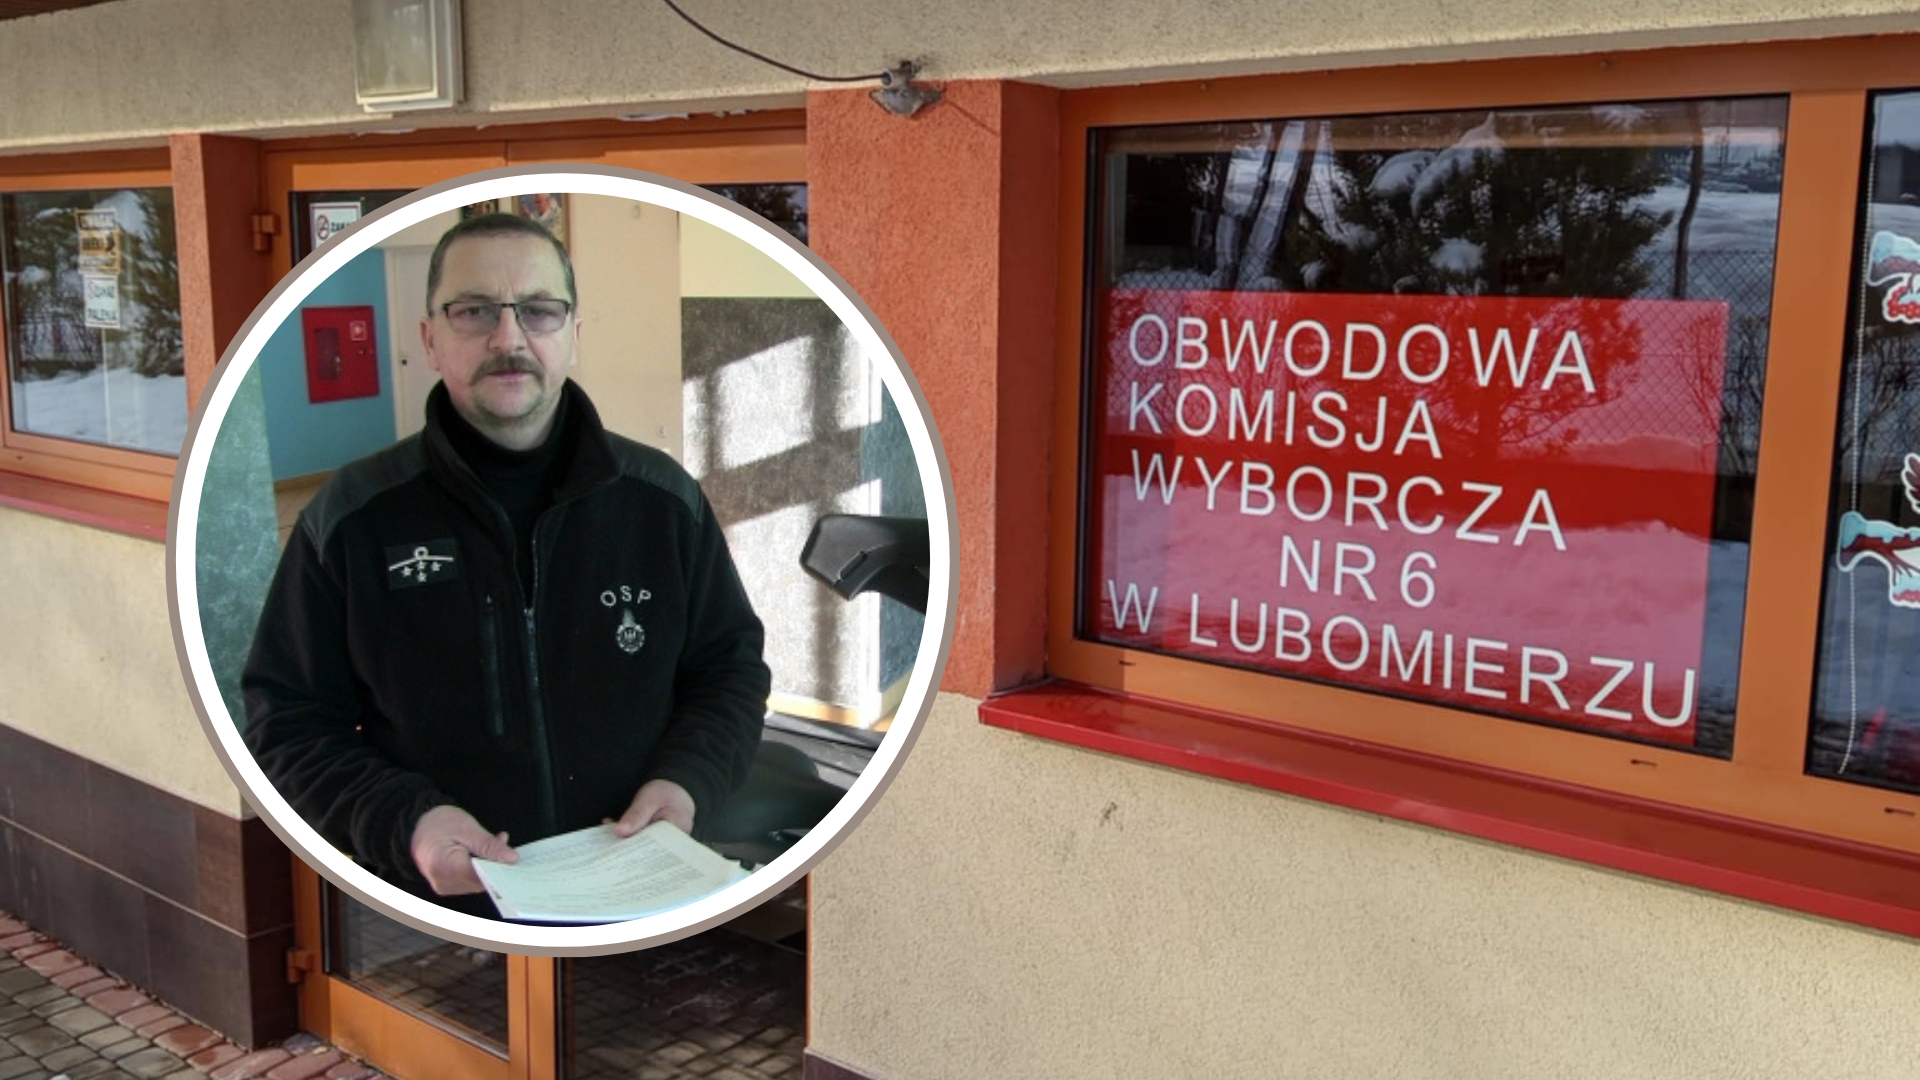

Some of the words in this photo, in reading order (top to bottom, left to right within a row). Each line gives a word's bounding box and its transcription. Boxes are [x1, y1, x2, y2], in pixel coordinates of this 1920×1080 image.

[1128, 313, 1596, 393] OBWODOWA
[1128, 381, 1443, 459] KOMISJA
[1131, 449, 1567, 551] WYBORCZA
[600, 585, 652, 607] OSP
[1279, 535, 1378, 601] NR
[1400, 552, 1438, 608] 6
[1107, 580, 1158, 634] W
[1190, 592, 1697, 728] LUBOMIERZU
